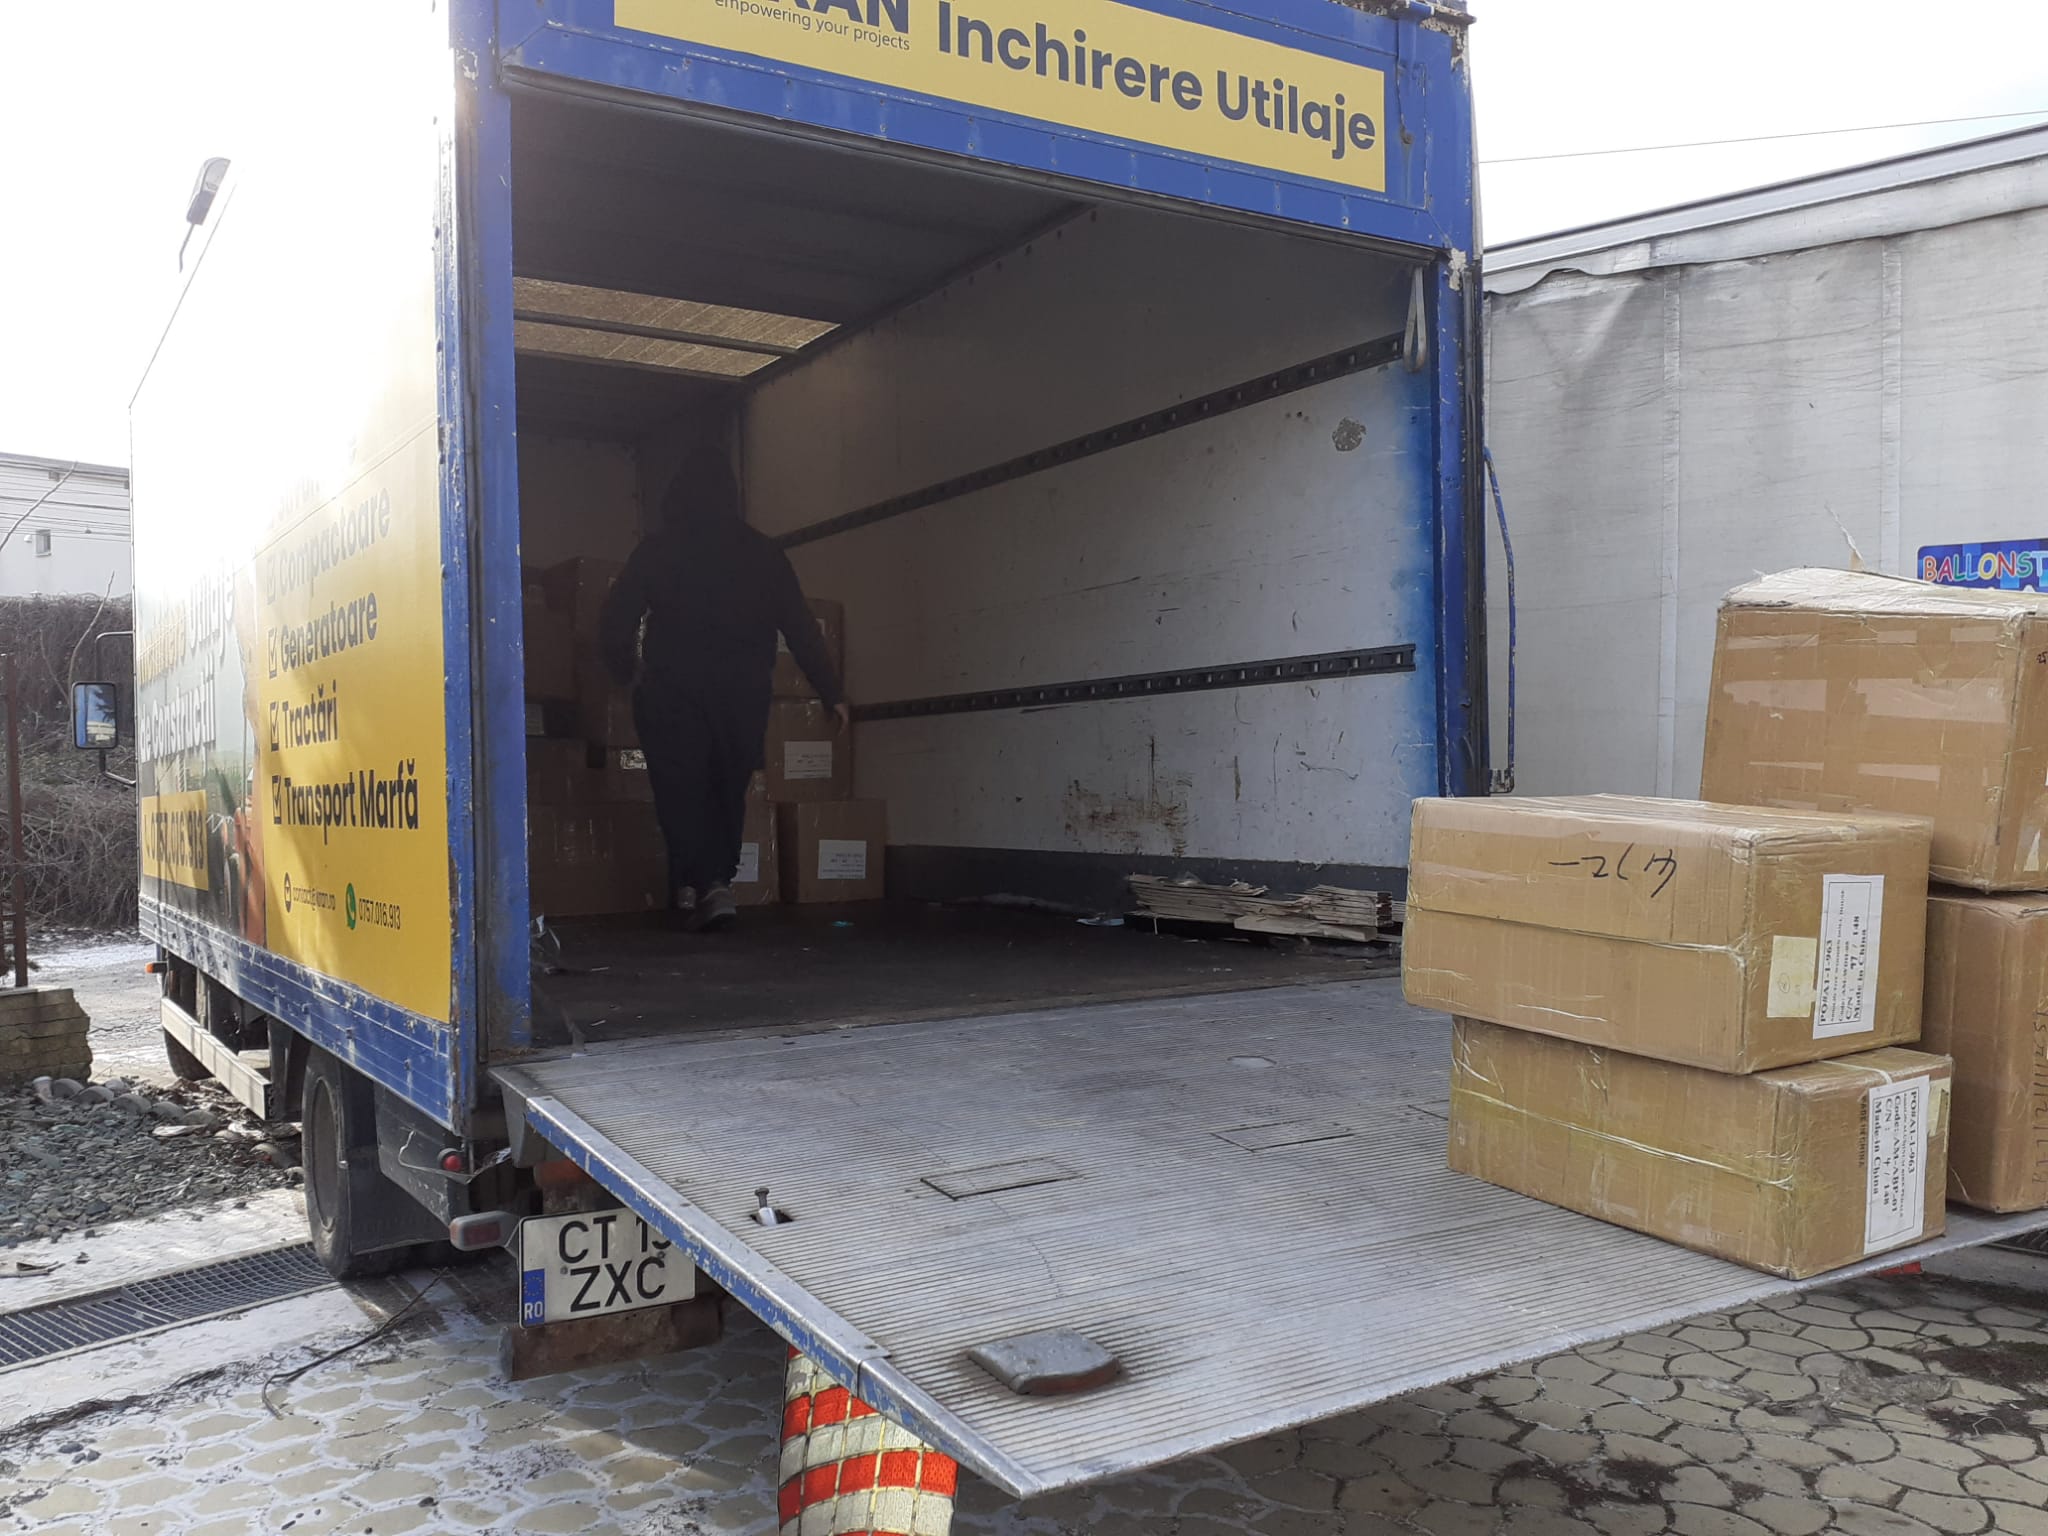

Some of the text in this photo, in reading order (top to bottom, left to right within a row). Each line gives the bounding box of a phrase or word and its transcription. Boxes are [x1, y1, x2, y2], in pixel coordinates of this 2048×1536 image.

[715, 0, 811, 30] empowering
[815, 17, 849, 35] your
[854, 26, 910, 51] projects
[938, 2, 1376, 160] Inchirere Utilaje
[280, 487, 391, 598] Compactoare
[280, 592, 377, 672] Generatoare
[282, 679, 337, 749] Tractări
[284, 758, 419, 846] Transport Marfă
[359, 897, 401, 930] 0757.016.913
[1859, 929, 1867, 966] China
[1908, 1090, 1918, 1174] PO#A1-1-963
[558, 1214, 672, 1264] CT 1
[523, 1301, 544, 1320] RO
[569, 1256, 666, 1313] ZXC
